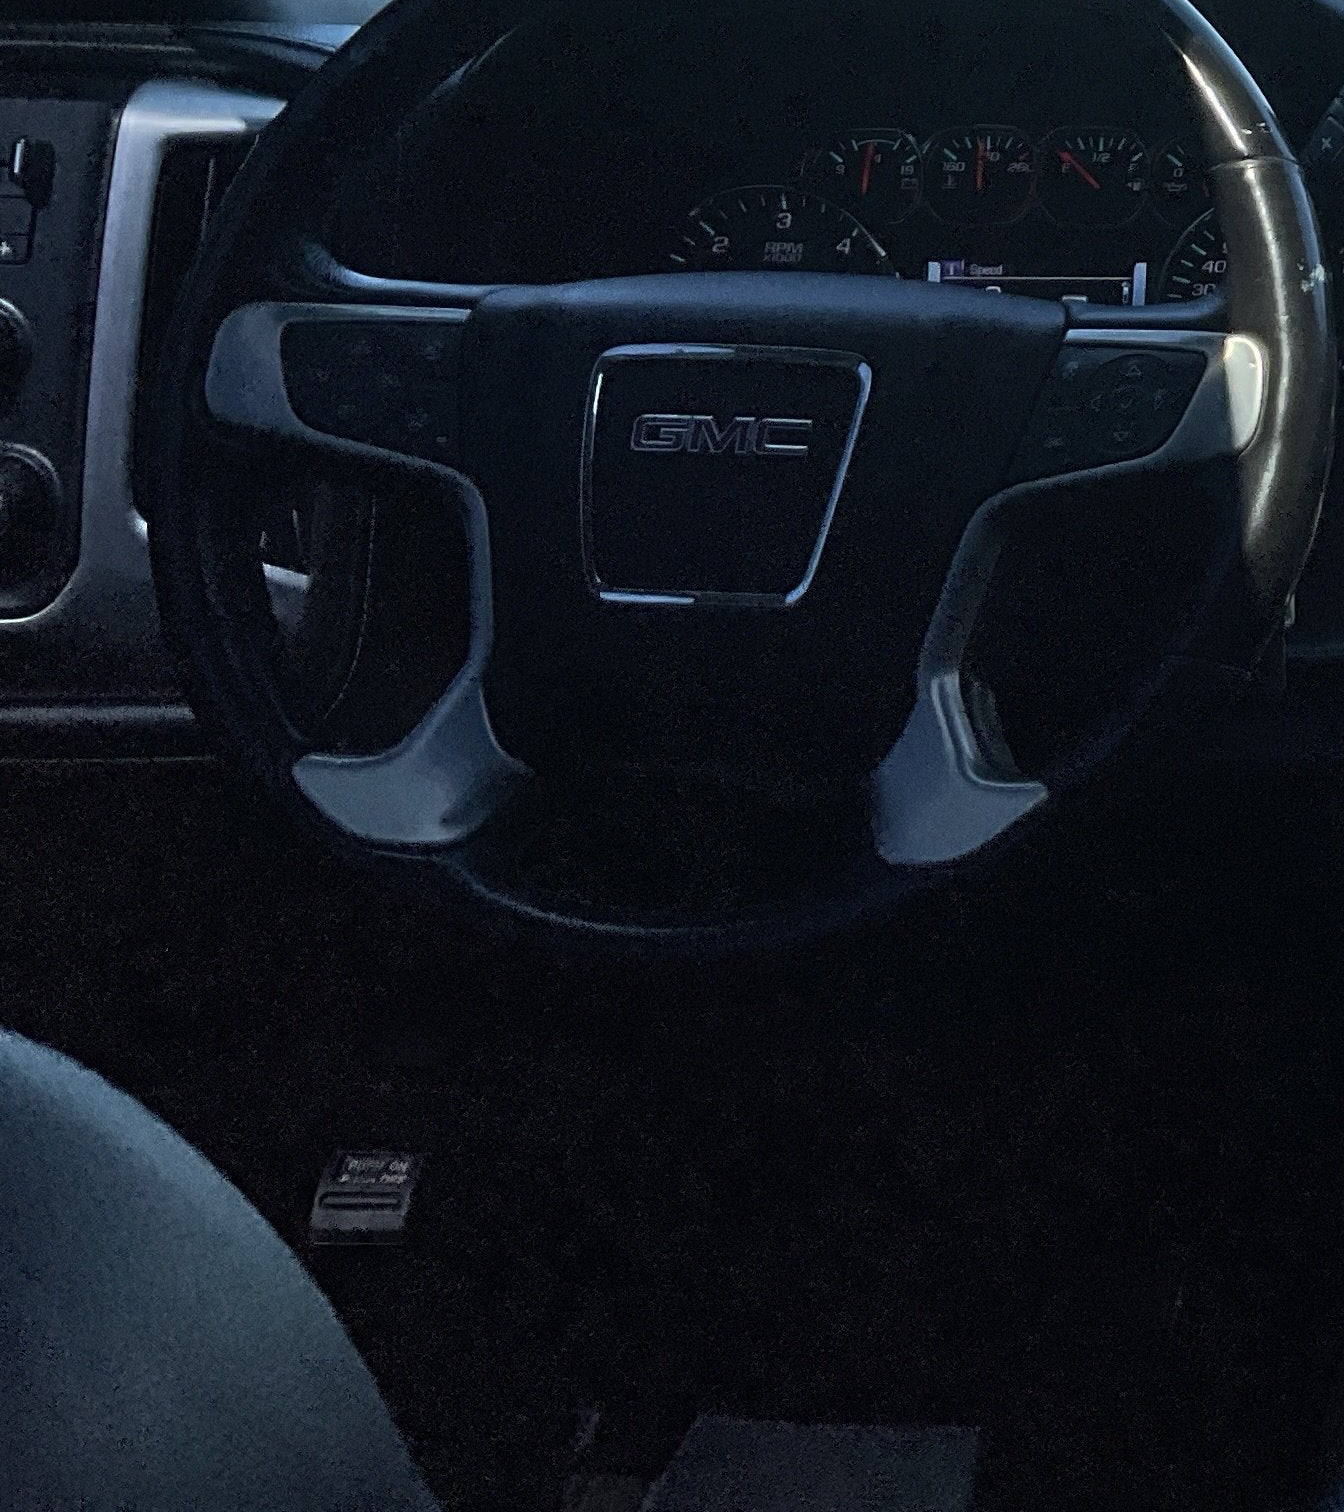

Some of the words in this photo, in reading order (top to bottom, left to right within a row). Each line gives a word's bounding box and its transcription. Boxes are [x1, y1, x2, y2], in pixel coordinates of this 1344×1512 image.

[776, 212, 793, 230] 3
[711, 236, 730, 254] 2
[764, 241, 804, 253] RPM
[836, 238, 851, 255] 4
[1201, 260, 1227, 274] 40
[630, 413, 814, 456] GMC
